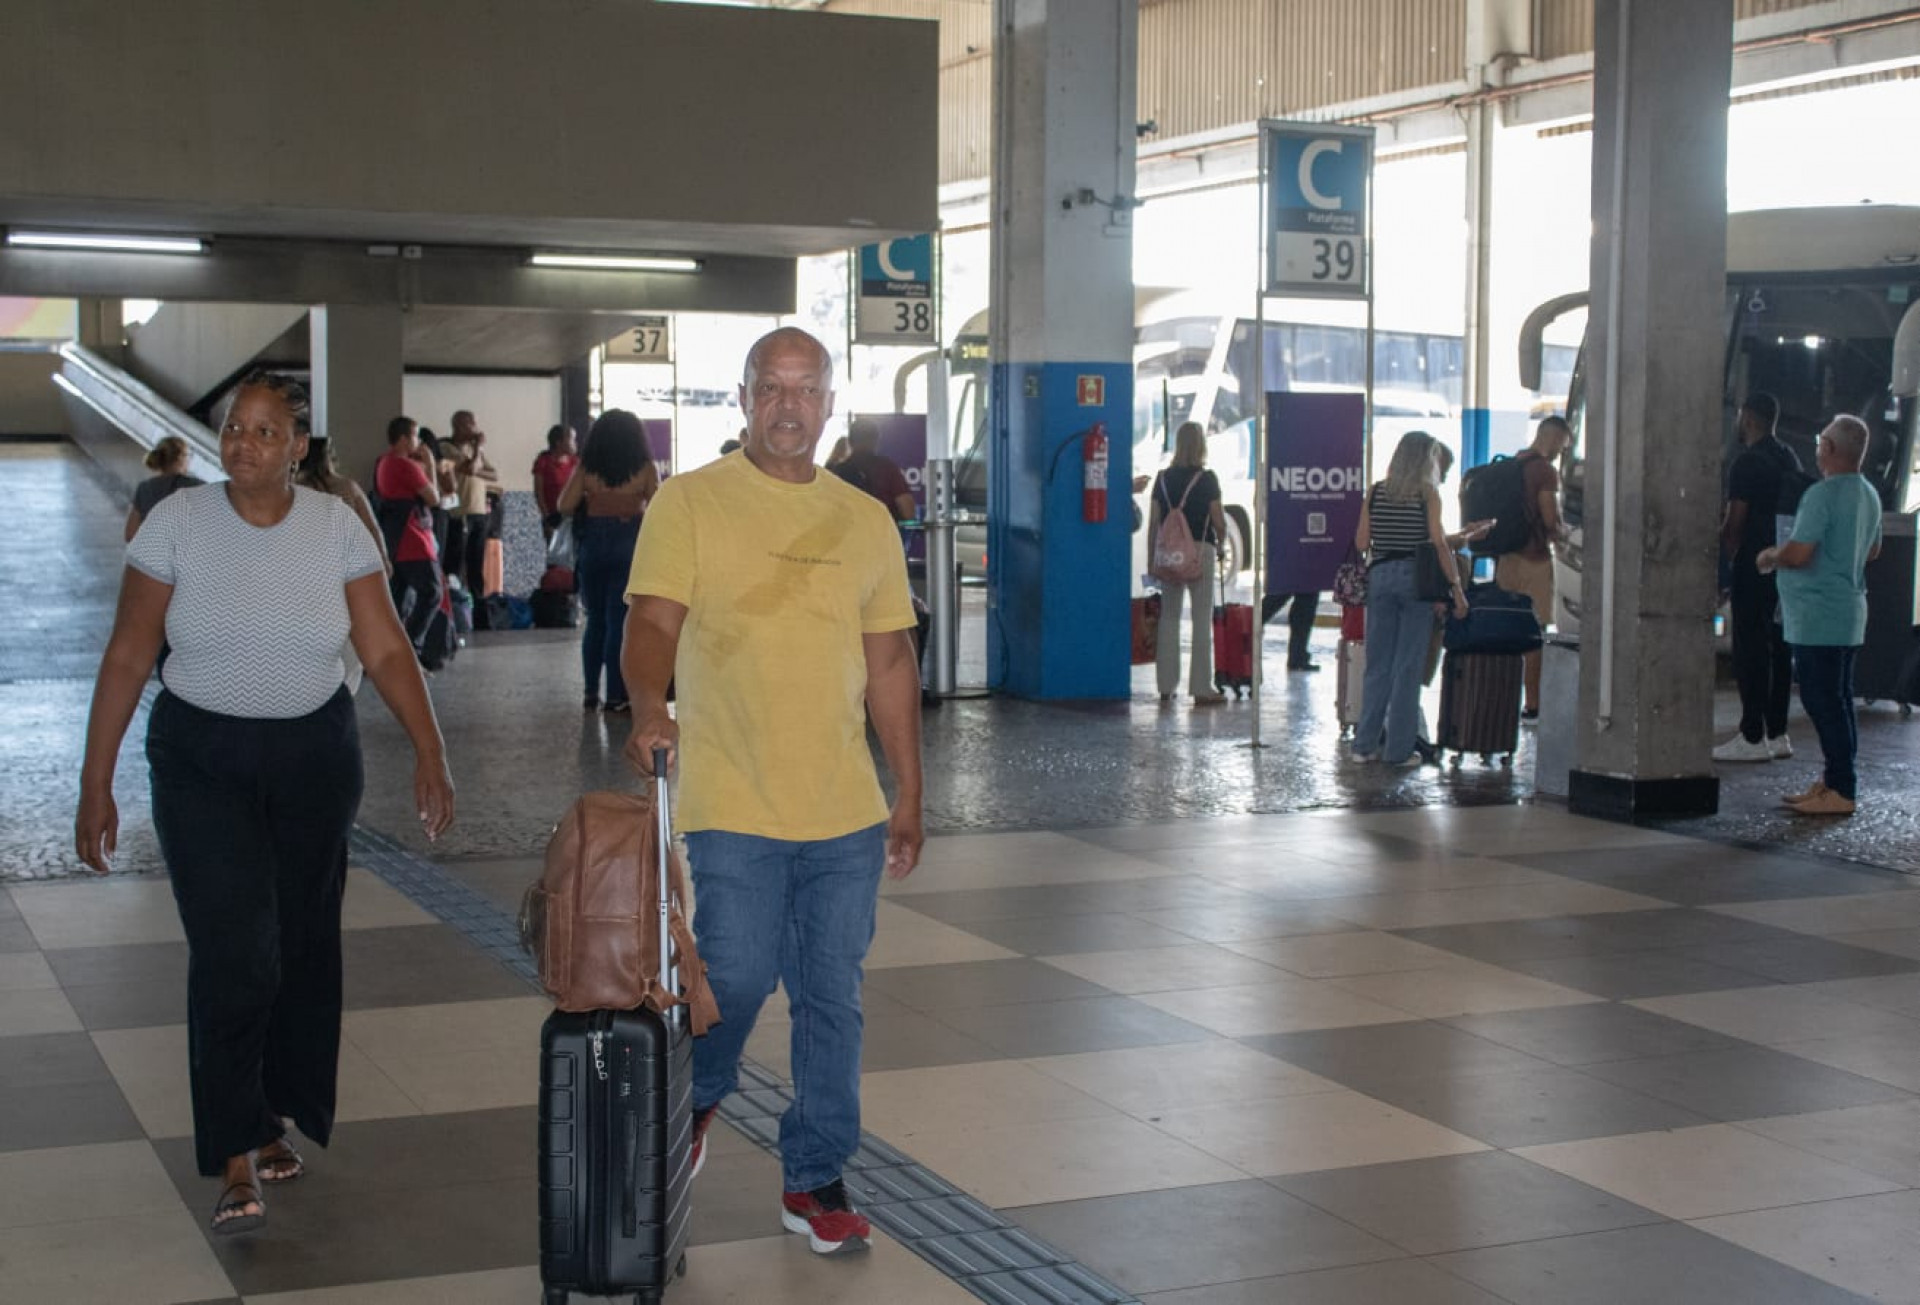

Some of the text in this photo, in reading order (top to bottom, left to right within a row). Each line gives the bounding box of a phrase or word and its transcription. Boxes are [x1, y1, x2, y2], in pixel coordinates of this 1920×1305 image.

[1298, 139, 1342, 209] C
[1312, 238, 1355, 280] 39
[894, 302, 930, 332] 38
[632, 329, 661, 353] 37
[1271, 467, 1361, 491] NEOOH
